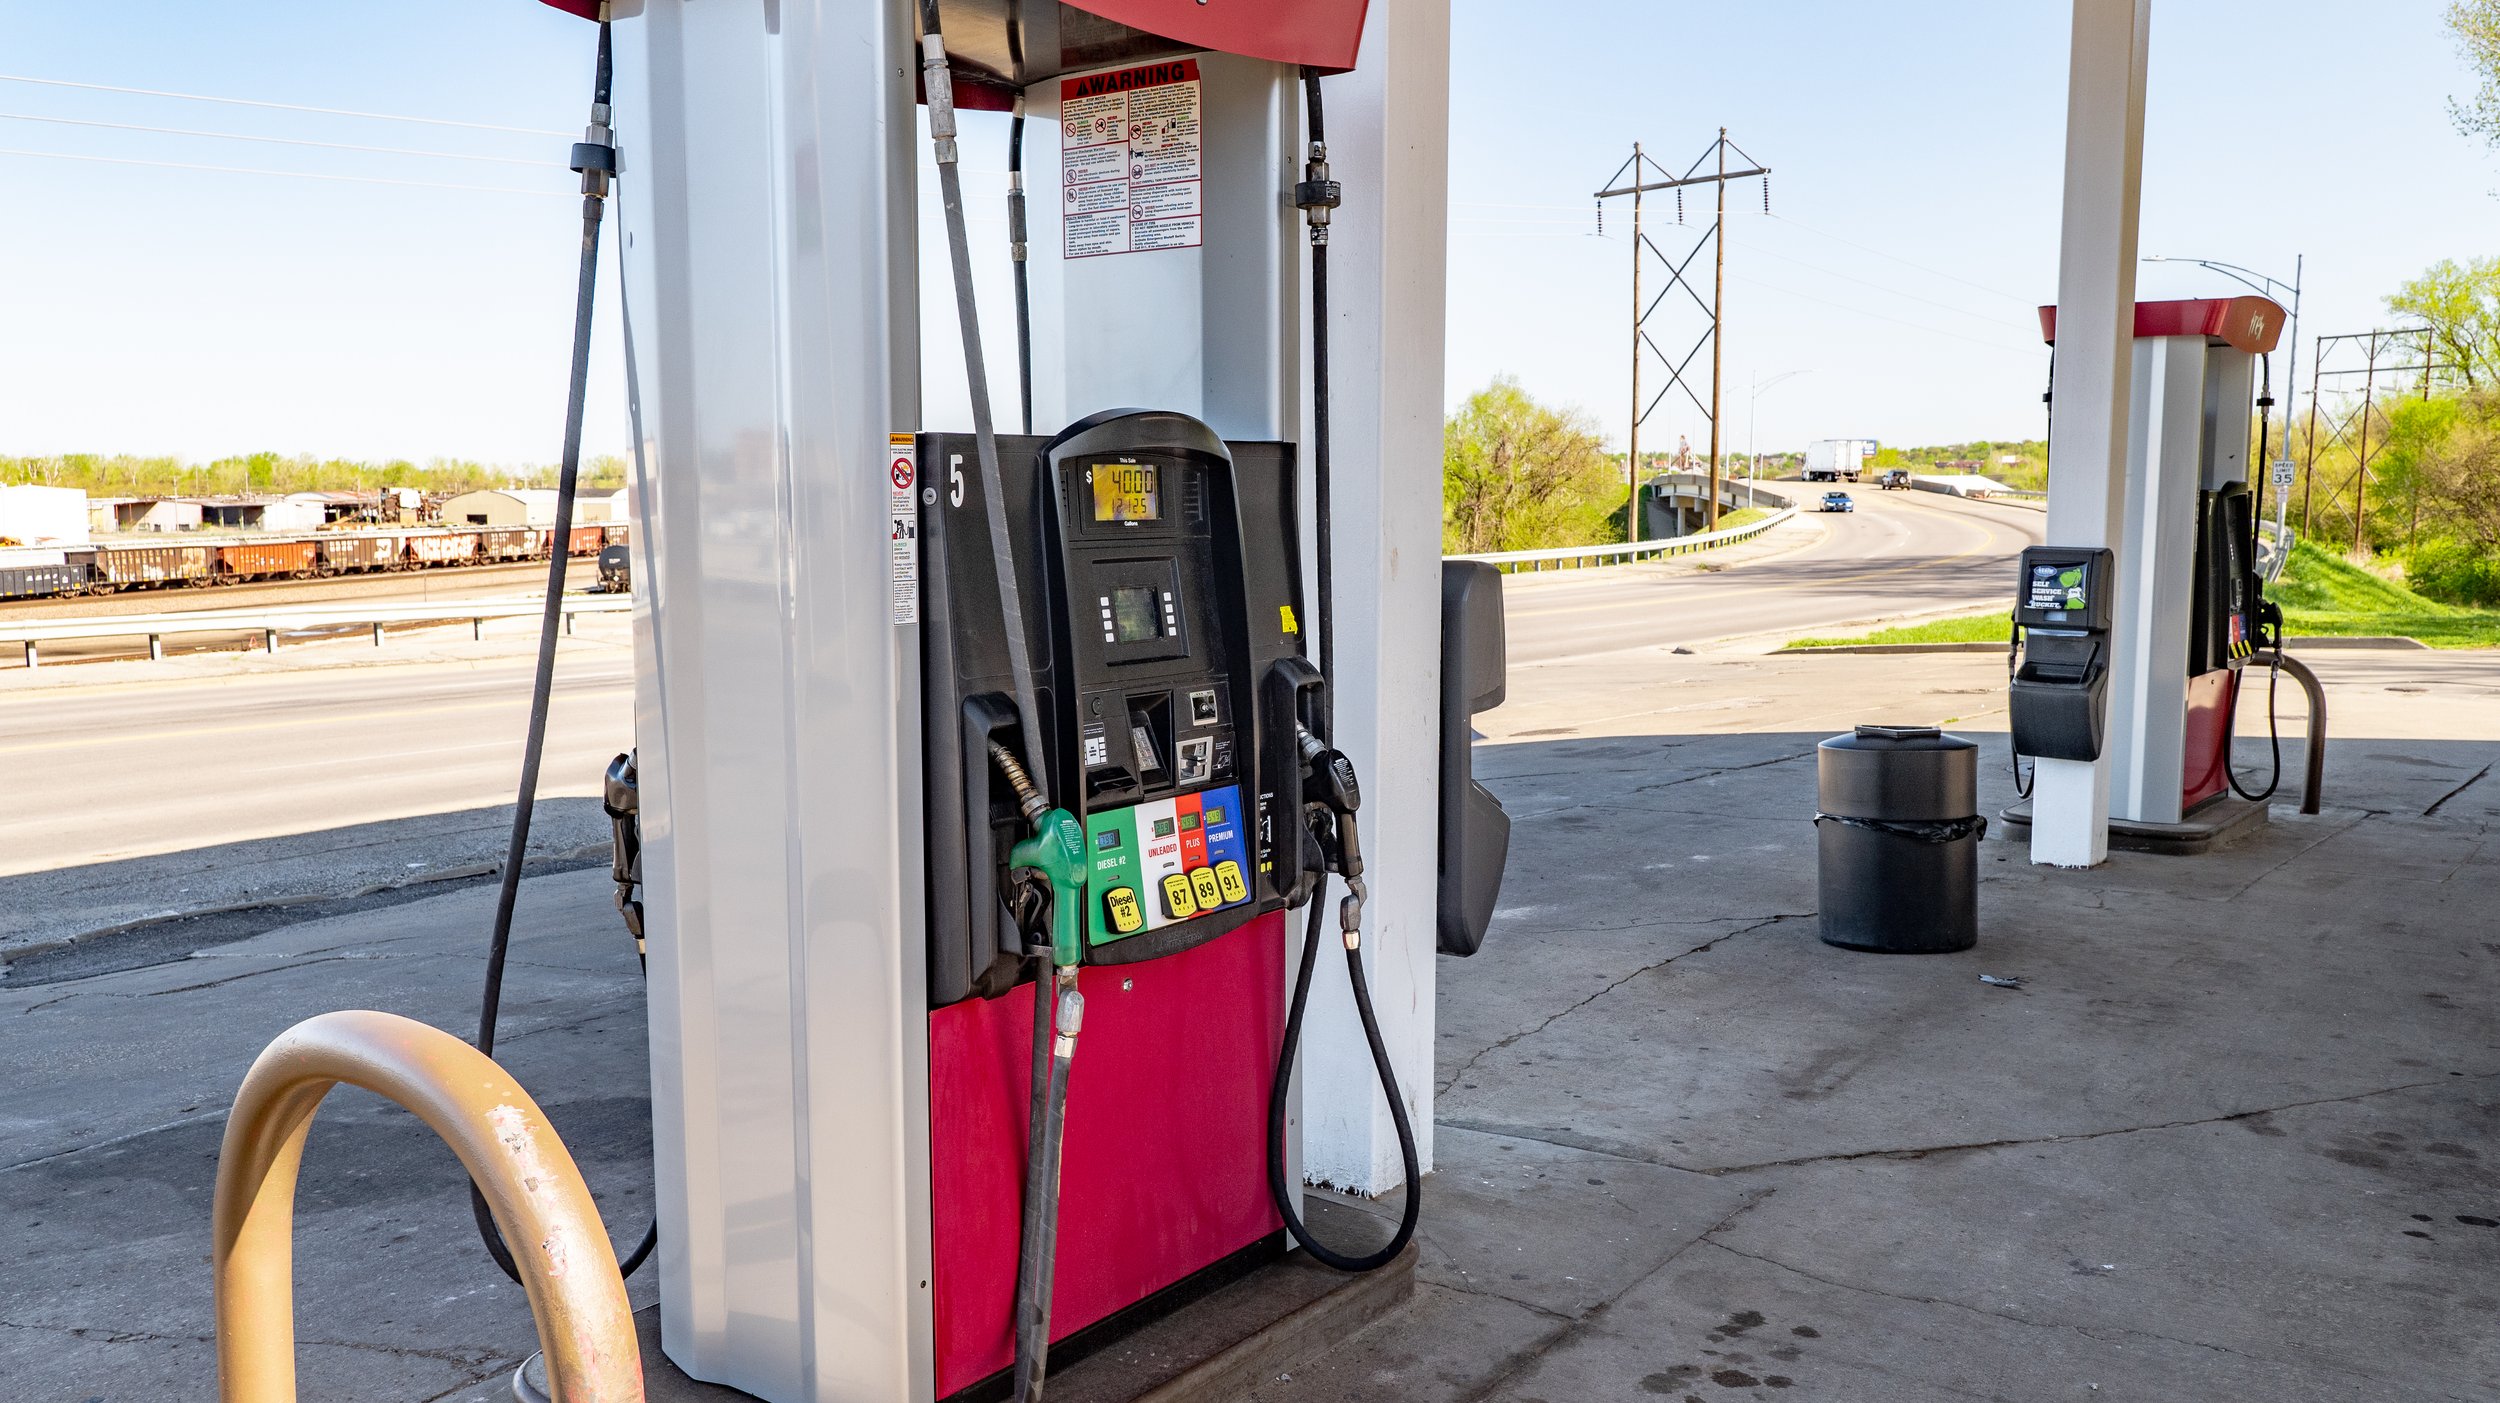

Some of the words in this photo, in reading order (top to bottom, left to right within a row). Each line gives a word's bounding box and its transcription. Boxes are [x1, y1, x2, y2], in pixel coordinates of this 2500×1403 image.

[1089, 64, 1184, 93] WARNING
[950, 454, 964, 508] 5
[1085, 470, 1093, 485] $
[1112, 470, 1153, 494] 40.00
[2274, 473, 2292, 483] 35
[1185, 837, 1201, 849] PLUS
[1208, 830, 1234, 844] PREMIUM
[1148, 843, 1178, 858] UNLEADED
[1097, 857, 1118, 871] DIESEL
[1118, 855, 1127, 865] #2
[1199, 881, 1215, 898] 89
[1223, 874, 1240, 891] 91
[1109, 891, 1134, 908] Diesel
[1172, 888, 1187, 906] 87
[1120, 905, 1132, 918] #2
